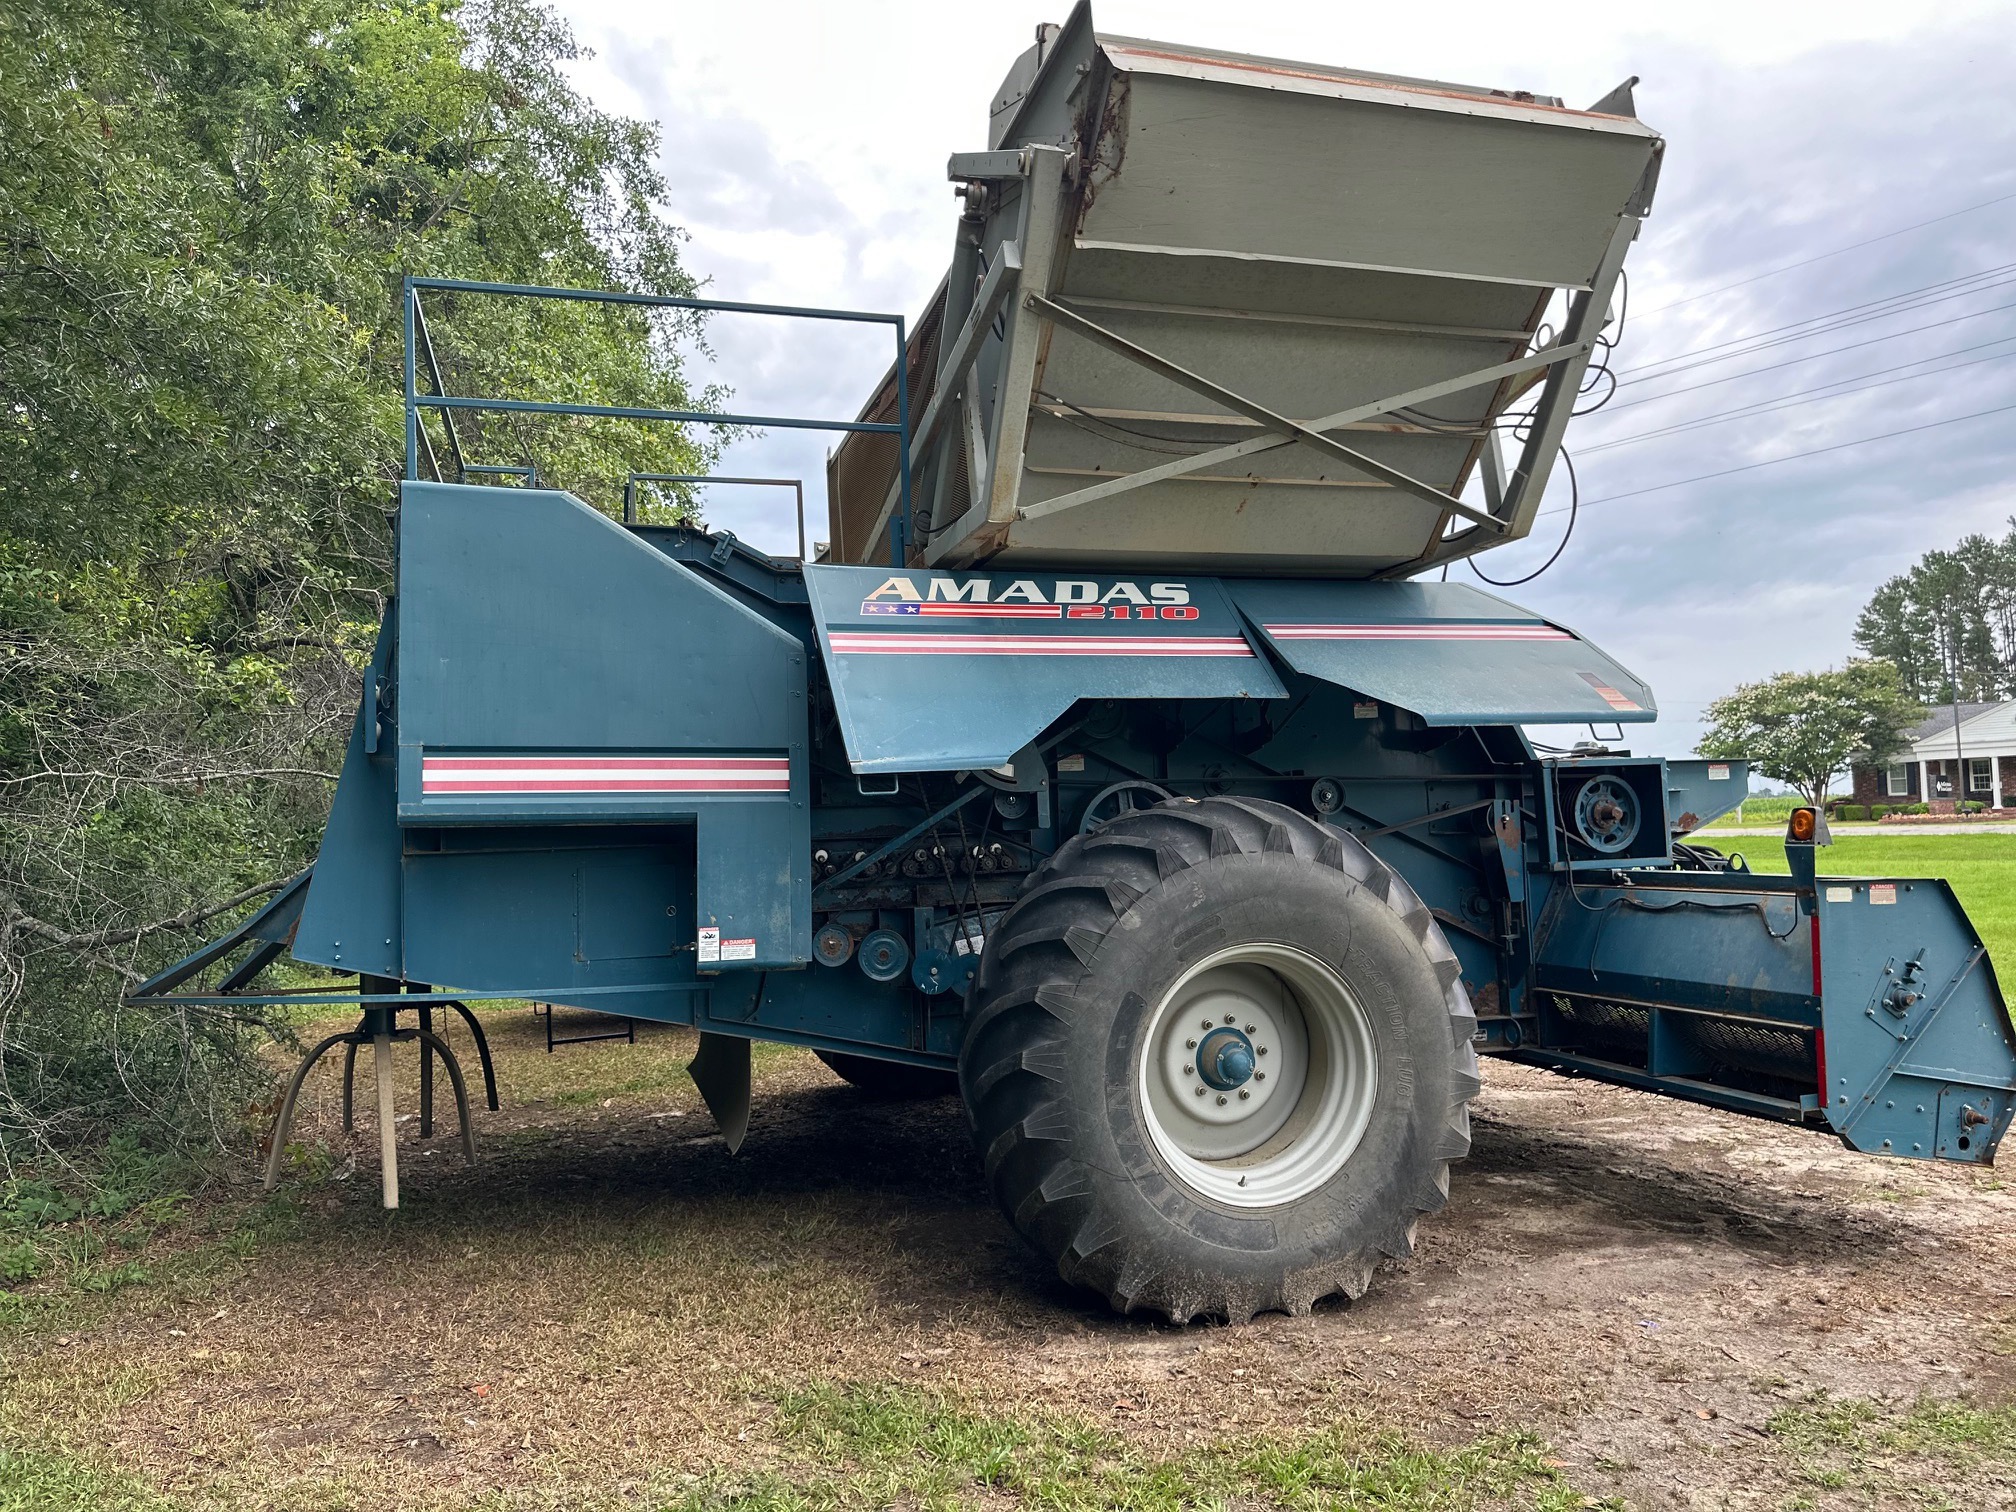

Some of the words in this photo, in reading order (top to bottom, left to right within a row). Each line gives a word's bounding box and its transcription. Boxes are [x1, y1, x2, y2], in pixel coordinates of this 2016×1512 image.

[864, 577, 1190, 605] AMADAS
[1066, 604, 1200, 620] 2110
[1396, 1056, 1413, 1097] LUG
